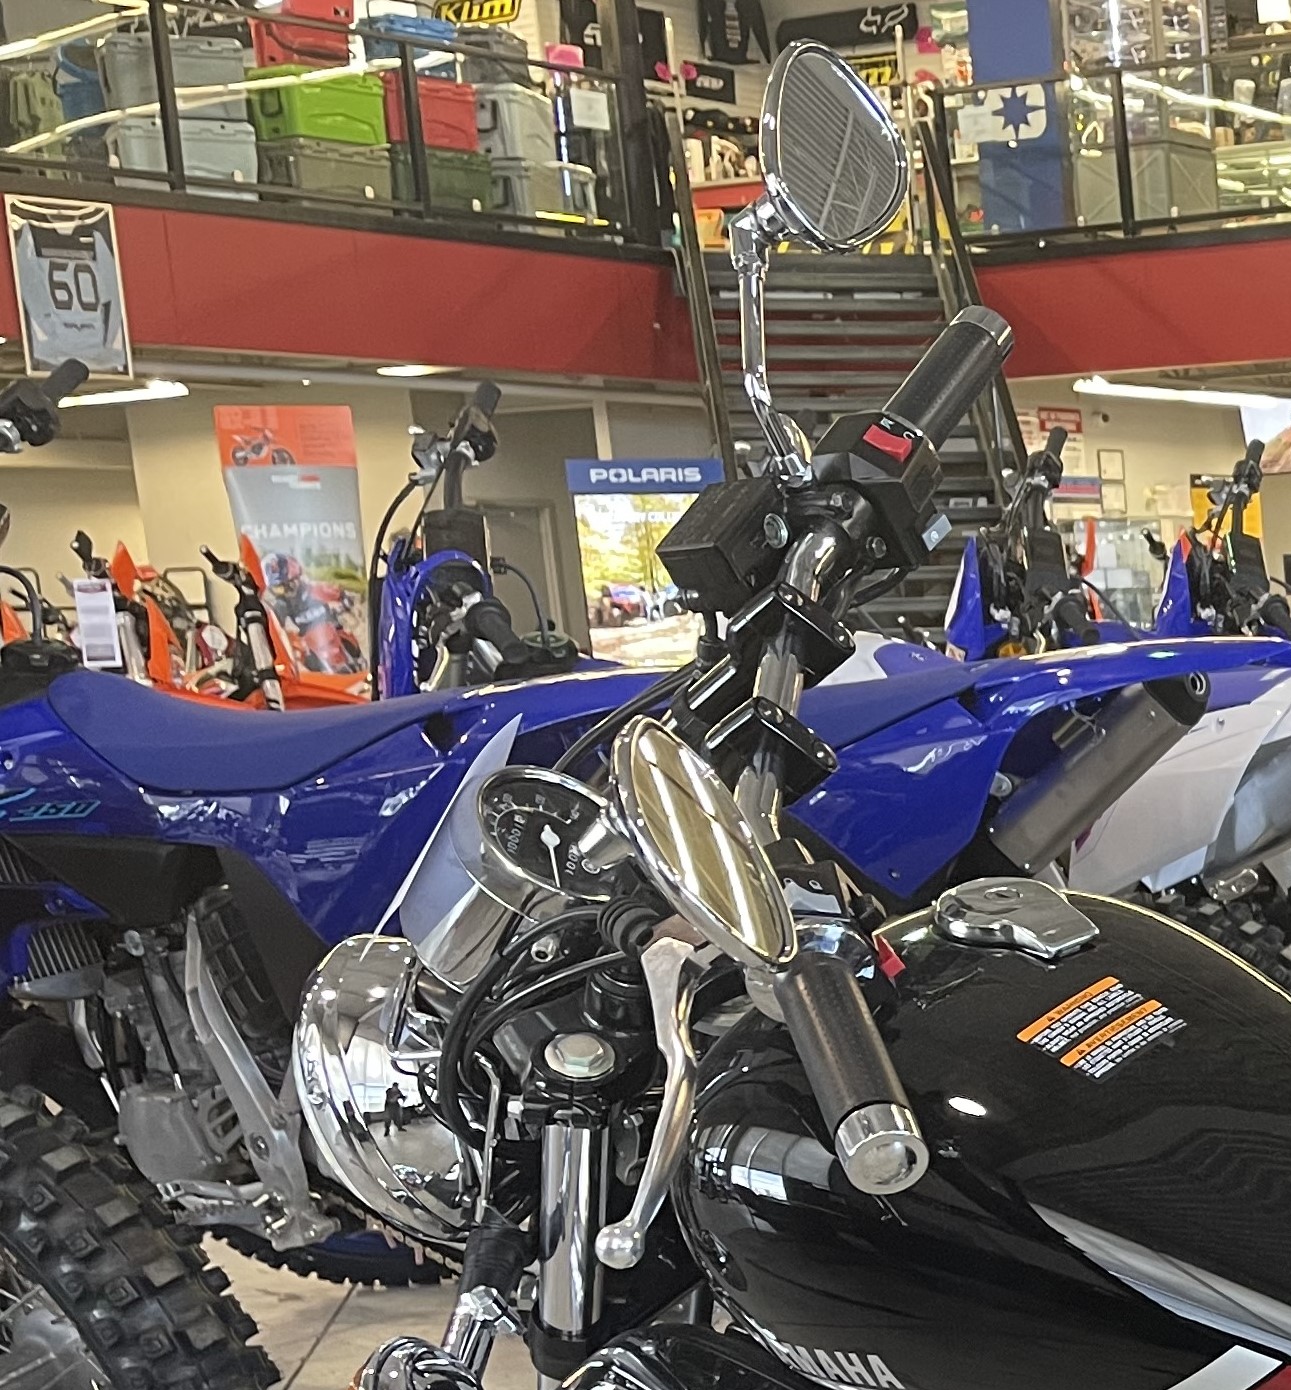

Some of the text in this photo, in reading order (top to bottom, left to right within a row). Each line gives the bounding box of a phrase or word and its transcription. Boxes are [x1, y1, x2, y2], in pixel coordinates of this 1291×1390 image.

[48, 259, 100, 311] 60
[589, 466, 702, 484] POLARIS
[240, 521, 357, 540] CHAMPIONS
